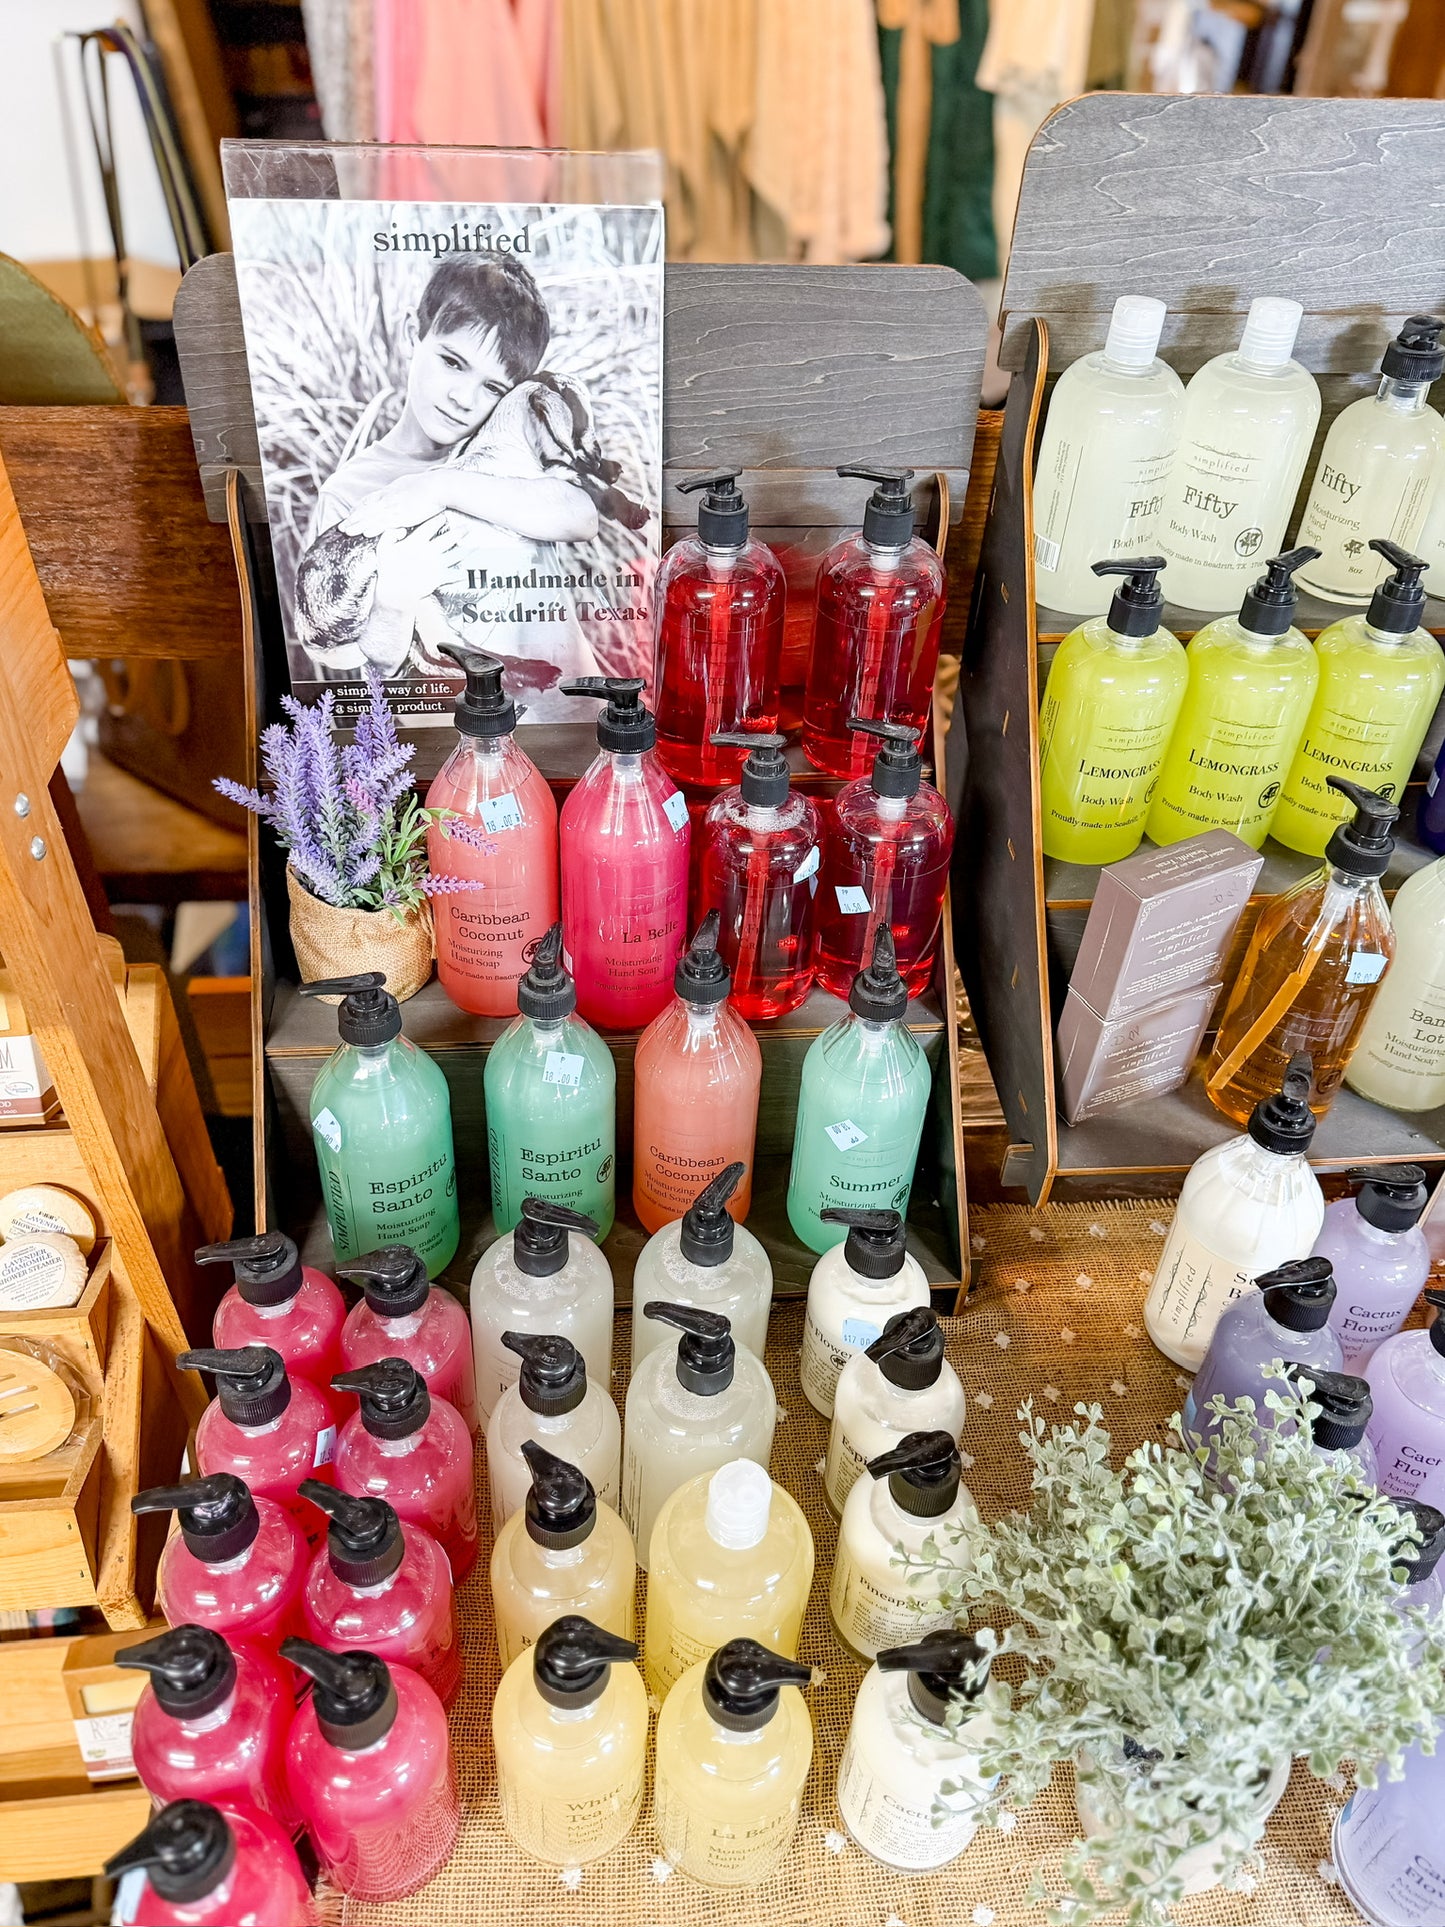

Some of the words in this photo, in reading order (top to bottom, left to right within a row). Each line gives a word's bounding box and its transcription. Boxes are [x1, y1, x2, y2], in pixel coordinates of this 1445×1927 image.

[373, 223, 532, 258] simplified
[1194, 455, 1250, 474] simplified
[1321, 464, 1362, 504] Fifty
[1182, 485, 1239, 519] Fifty
[1308, 514, 1328, 531] Hand
[1312, 501, 1361, 531] Moisturizing
[1169, 519, 1189, 538] Body
[1192, 528, 1218, 544] Wash
[1304, 526, 1322, 546] Soap
[467, 568, 608, 590] Handmade
[615, 567, 642, 588] in
[462, 602, 569, 624] Seadrift
[576, 602, 648, 622] Texas
[387, 687, 412, 698] way
[414, 684, 428, 695] of
[430, 683, 453, 695] life.
[335, 704, 345, 715] a
[397, 702, 446, 713] product.
[1189, 749, 1280, 776] LEMONGRASS
[1302, 740, 1394, 773] LEMONGRASS
[1189, 785, 1214, 801] Body
[1217, 792, 1243, 803] Wash
[1300, 776, 1325, 794] Body
[1081, 795, 1107, 808] Body
[1298, 801, 1319, 815] made
[1320, 810, 1329, 819] in
[1051, 809, 1080, 827] Proudly
[1081, 821, 1103, 829] made
[1187, 811, 1210, 823] made
[1210, 815, 1219, 825] in
[450, 906, 531, 925] Caribbean
[458, 926, 525, 942] Coconut
[622, 932, 641, 944] La
[648, 921, 679, 941] Belle
[1158, 929, 1210, 954] simplified
[447, 937, 504, 958] Moisturizing
[450, 950, 474, 966] Hand
[476, 957, 501, 969] Soap
[605, 954, 663, 967] Moisturizing
[464, 971, 484, 980] made
[608, 968, 635, 977] Hand
[637, 966, 660, 976] Soap
[1120, 1046, 1172, 1070] simplified
[1384, 1043, 1412, 1060] Hand
[1414, 1055, 1439, 1066] Soap
[520, 1138, 601, 1166] Espiritu
[650, 1145, 725, 1168] Caribbean
[369, 1153, 448, 1195] Espiritu
[522, 1167, 582, 1183] Santo
[655, 1163, 718, 1181] Coconut
[643, 1169, 696, 1196] Moisturizing
[830, 1174, 904, 1193] Summer
[372, 1188, 433, 1214] Santo
[524, 1189, 584, 1201] Moisturizing
[645, 1181, 668, 1199] Hand
[669, 1193, 692, 1205] Soap
[819, 1191, 877, 1209] Moisturizing
[328, 1170, 350, 1250] SIMPLIFIED
[376, 1208, 436, 1231] Moisturizing
[25, 1212, 66, 1234] LAVENDER
[378, 1228, 405, 1240] Hand
[408, 1219, 431, 1234] Soap
[418, 1231, 440, 1248] made
[2, 1252, 53, 1277] CHAMOMILE
[4, 1249, 47, 1269] LAVENDER
[28, 1256, 62, 1274] STEAMER
[1170, 1262, 1198, 1325] simplified
[1349, 1305, 1402, 1319] Cactus
[1341, 1318, 1395, 1333] Flower
[815, 1327, 853, 1359] Flower
[1383, 1480, 1417, 1496] Hand
[567, 1784, 624, 1811] White
[566, 1811, 603, 1822] Tea
[712, 1829, 736, 1839] La
